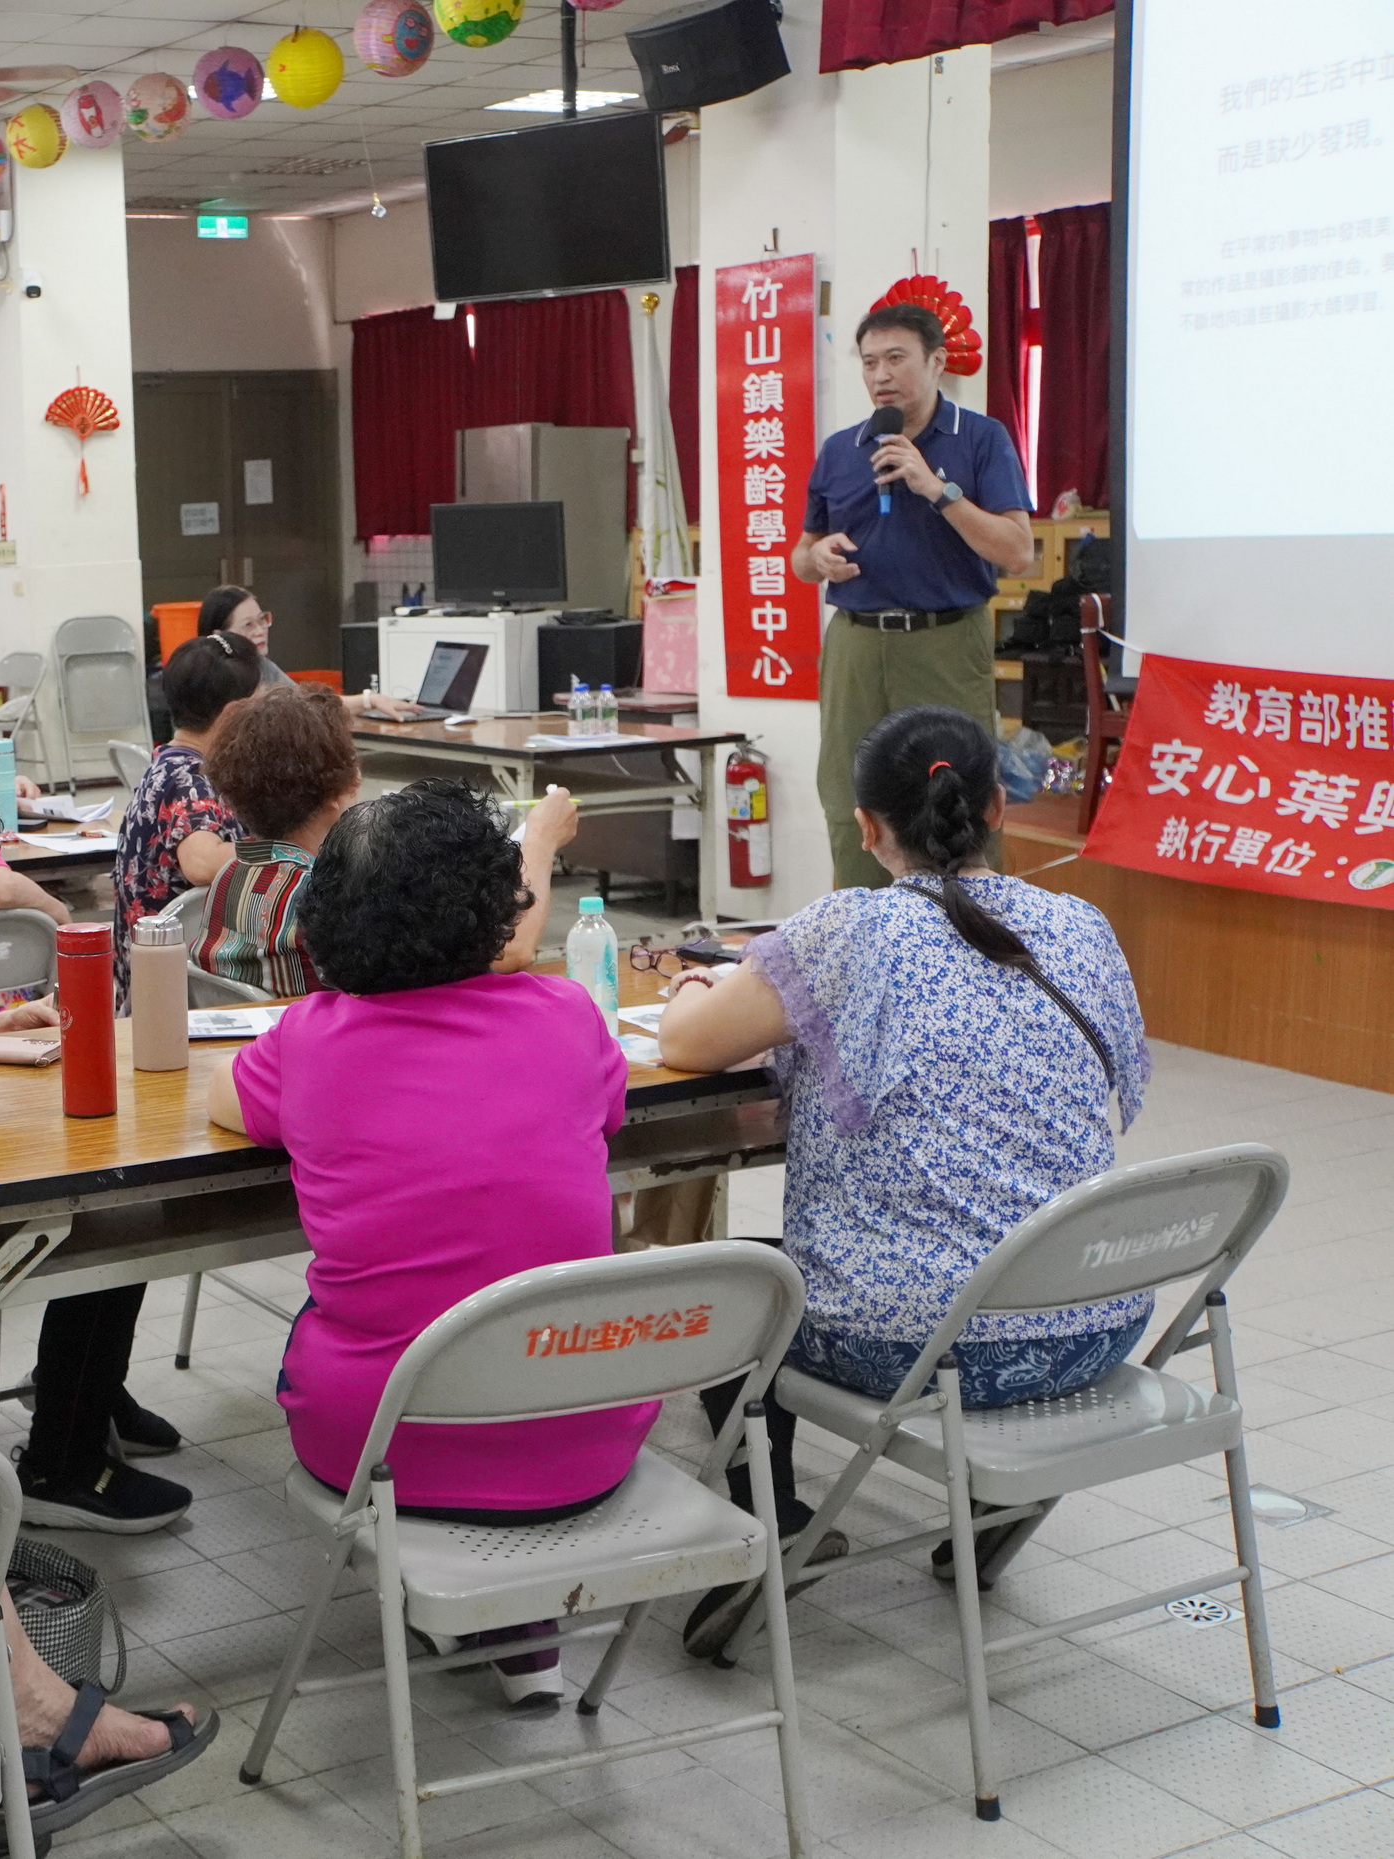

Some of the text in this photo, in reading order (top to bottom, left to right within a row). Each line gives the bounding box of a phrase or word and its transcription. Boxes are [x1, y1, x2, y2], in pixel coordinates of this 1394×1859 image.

[741, 277, 793, 687] 竹山鎮樂齡學習中心
[1203, 679, 1394, 751] 教育部推
